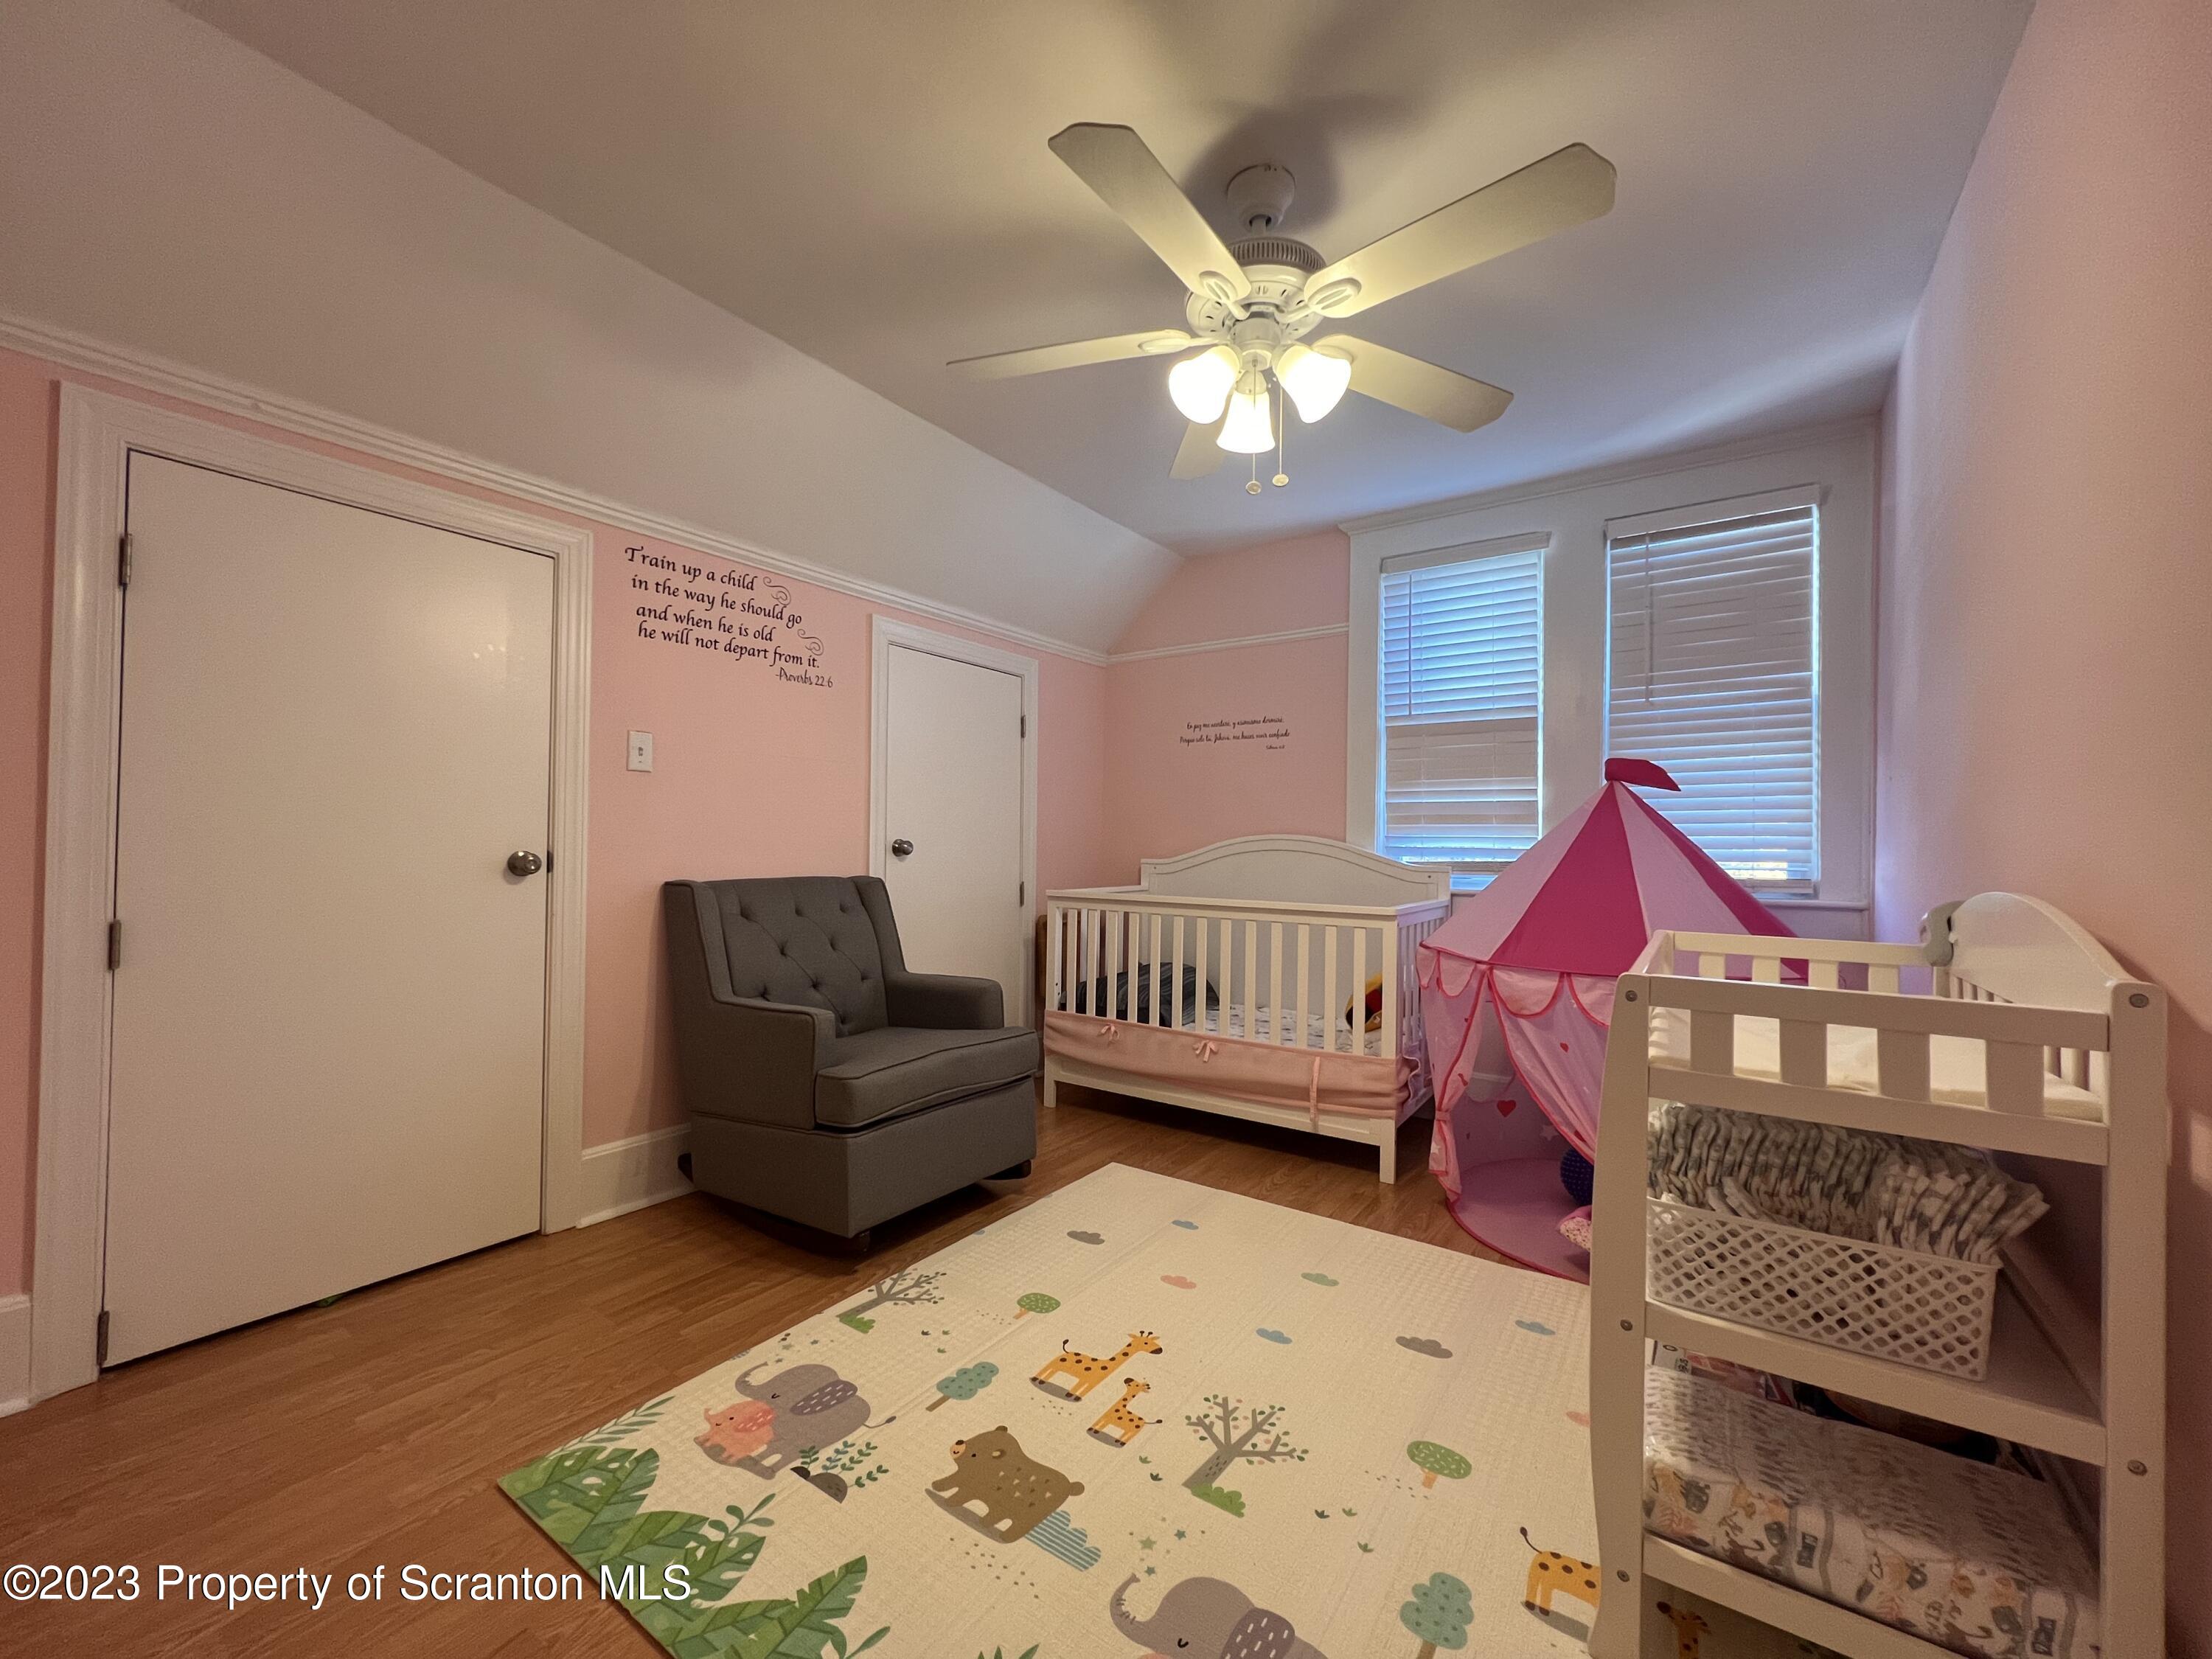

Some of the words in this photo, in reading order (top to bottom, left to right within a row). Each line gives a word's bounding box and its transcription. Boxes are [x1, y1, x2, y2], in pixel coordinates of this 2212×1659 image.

[625, 546, 677, 572] Train
[682, 564, 702, 583] up
[706, 571, 716, 582] a
[720, 569, 758, 591] child
[631, 574, 649, 591] in
[654, 577, 680, 597] the
[684, 589, 716, 612] way
[720, 591, 737, 610] he
[740, 598, 785, 622] should
[786, 613, 802, 629] go
[636, 604, 672, 622] and
[672, 609, 713, 630] when
[718, 616, 734, 634] he
[738, 623, 749, 637] is
[753, 625, 776, 642] old
[638, 619, 656, 639] he
[661, 627, 694, 645] will
[695, 637, 720, 650] not
[723, 636, 770, 661] depart
[769, 646, 803, 667] from
[807, 655, 821, 669] it.
